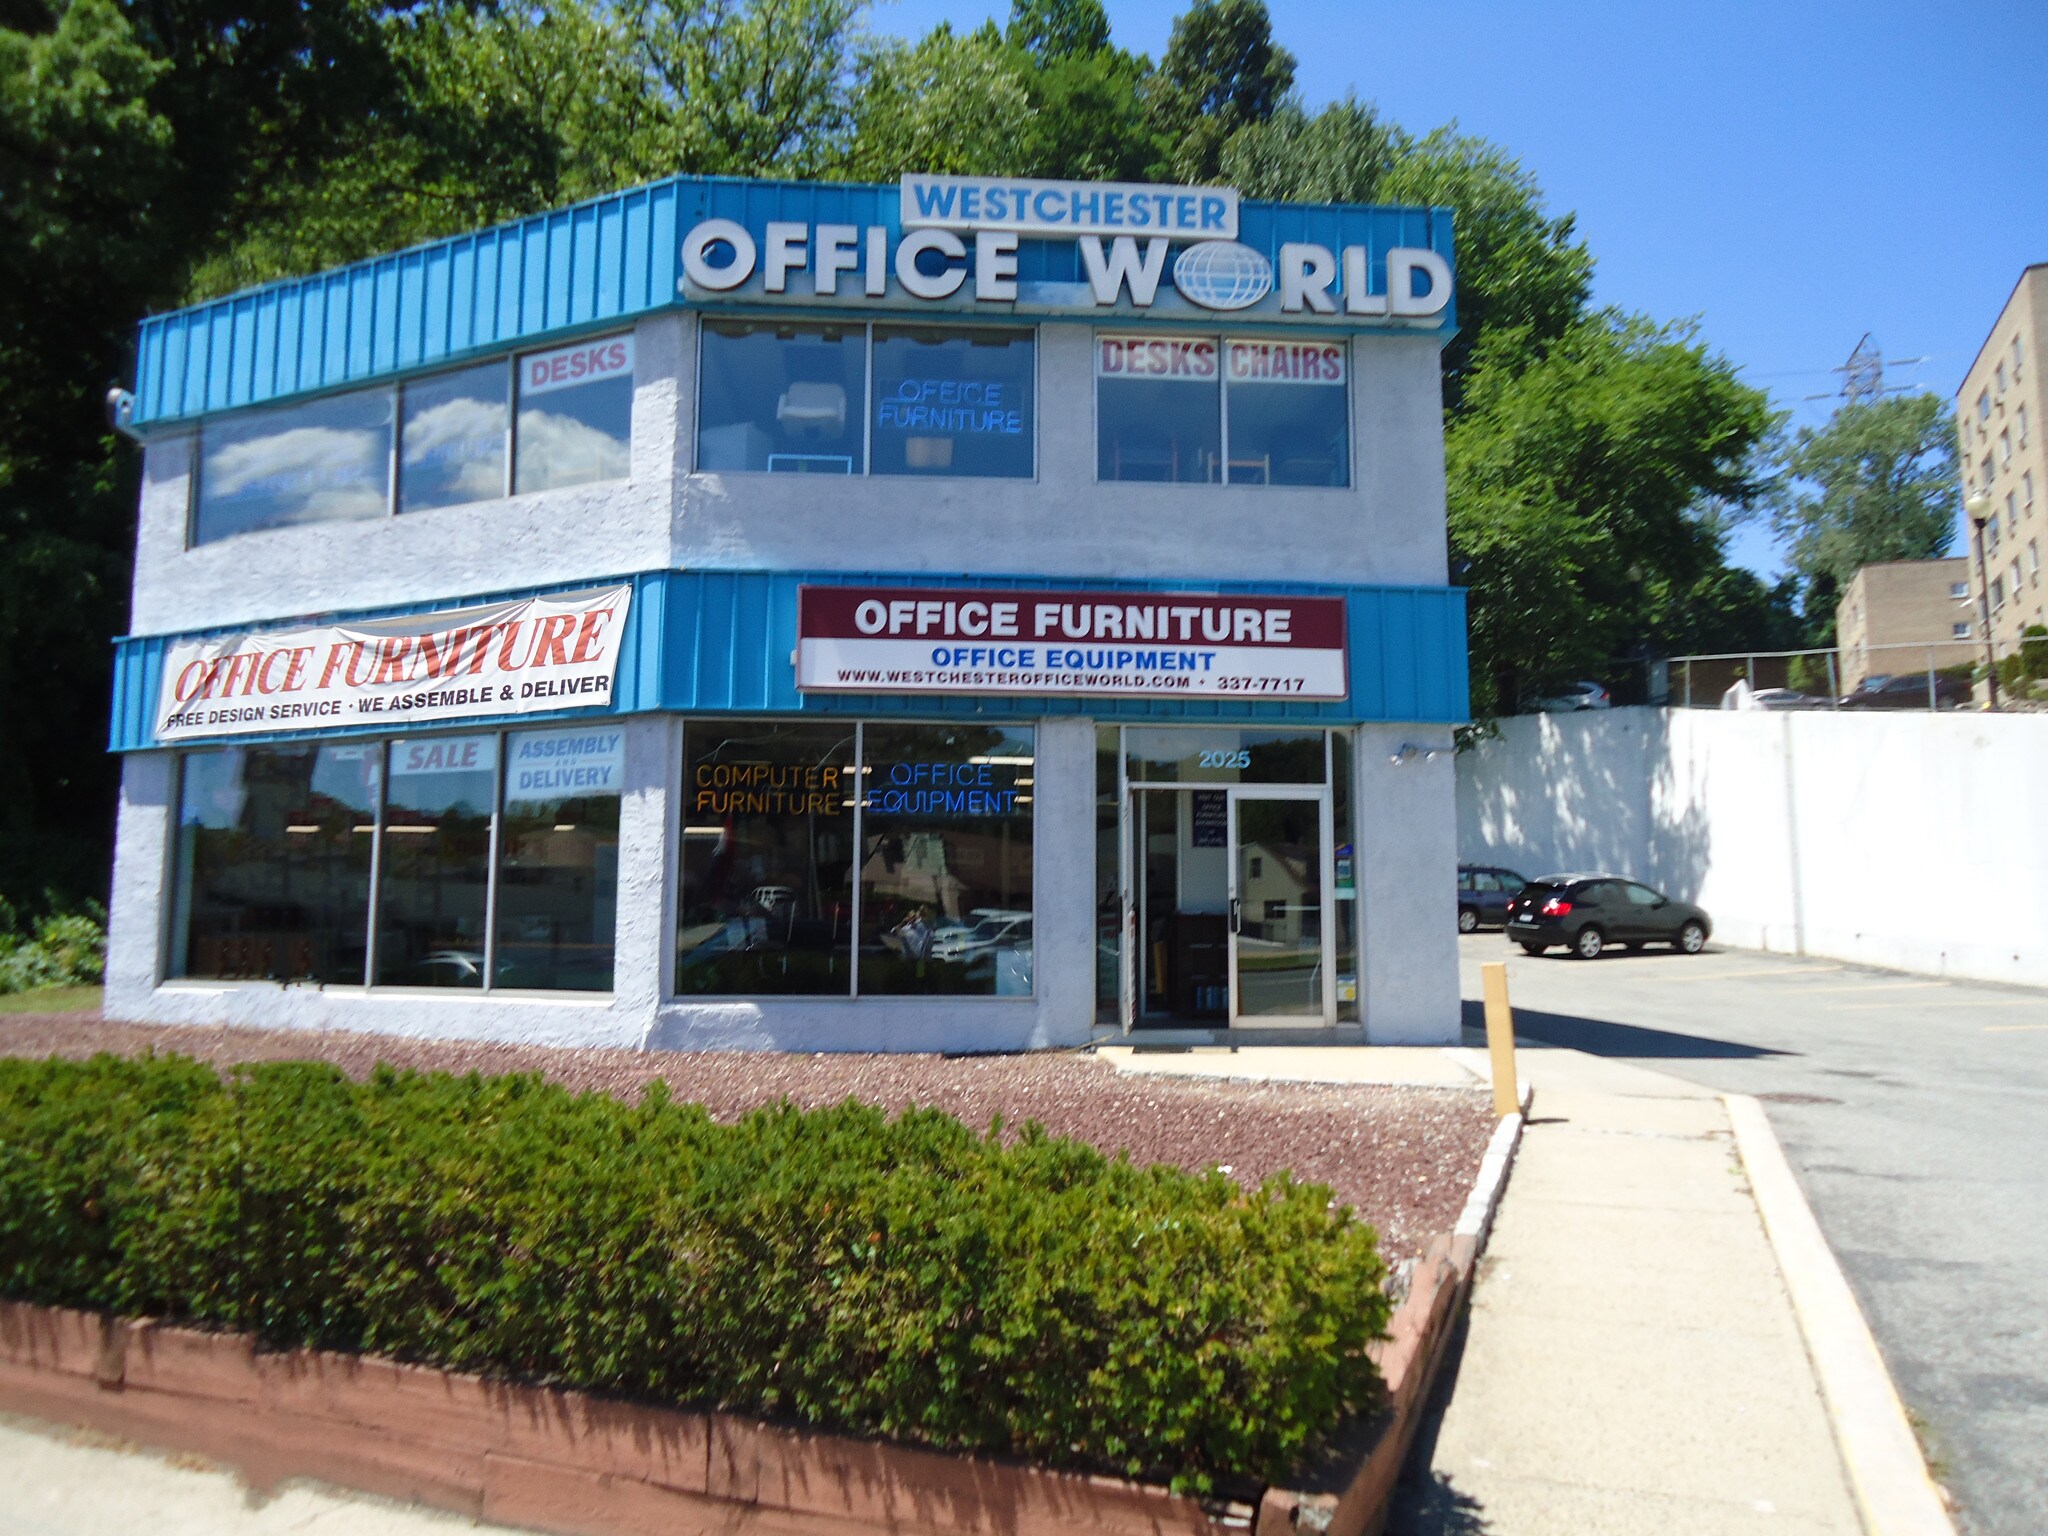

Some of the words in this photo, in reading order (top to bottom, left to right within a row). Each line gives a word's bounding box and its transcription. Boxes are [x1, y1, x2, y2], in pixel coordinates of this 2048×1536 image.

[913, 183, 1227, 230] WESTCHESTER
[681, 218, 1020, 302] OFFICE
[531, 343, 627, 387] DESKS
[1102, 340, 1216, 376] DESKS
[1231, 343, 1342, 380] CHAIRS
[898, 379, 1003, 407] OFFICE
[878, 403, 1023, 434] FURNITURE
[854, 599, 1019, 637] OFFICE
[1034, 603, 1293, 643] FURNITURE
[174, 646, 316, 703] OFFICE
[315, 608, 614, 690] FURNITURE
[931, 647, 1036, 668] OFFICE
[1046, 650, 1217, 671] EQUIPMENT
[837, 669, 1190, 688] WWW.WESTCHESTEROFFICEWORLD.COM
[1217, 675, 1305, 692] 337-7717
[167, 711, 204, 728] FREE
[208, 707, 265, 724] DESIGN
[269, 700, 342, 720] SERVICE
[358, 695, 384, 713] WE
[388, 686, 493, 711] ASSEMBLE
[499, 684, 515, 701] &
[521, 675, 610, 698] DELIVER
[405, 741, 480, 770] SALE
[520, 734, 620, 759] ASSEMBLY
[1199, 750, 1251, 769] 2025
[519, 766, 613, 790] DELIVERY
[696, 763, 838, 790] COMPUTER
[889, 763, 993, 786] OFFICE
[696, 789, 842, 816] FURNITURE
[865, 789, 1017, 814] EQUIPMENT
